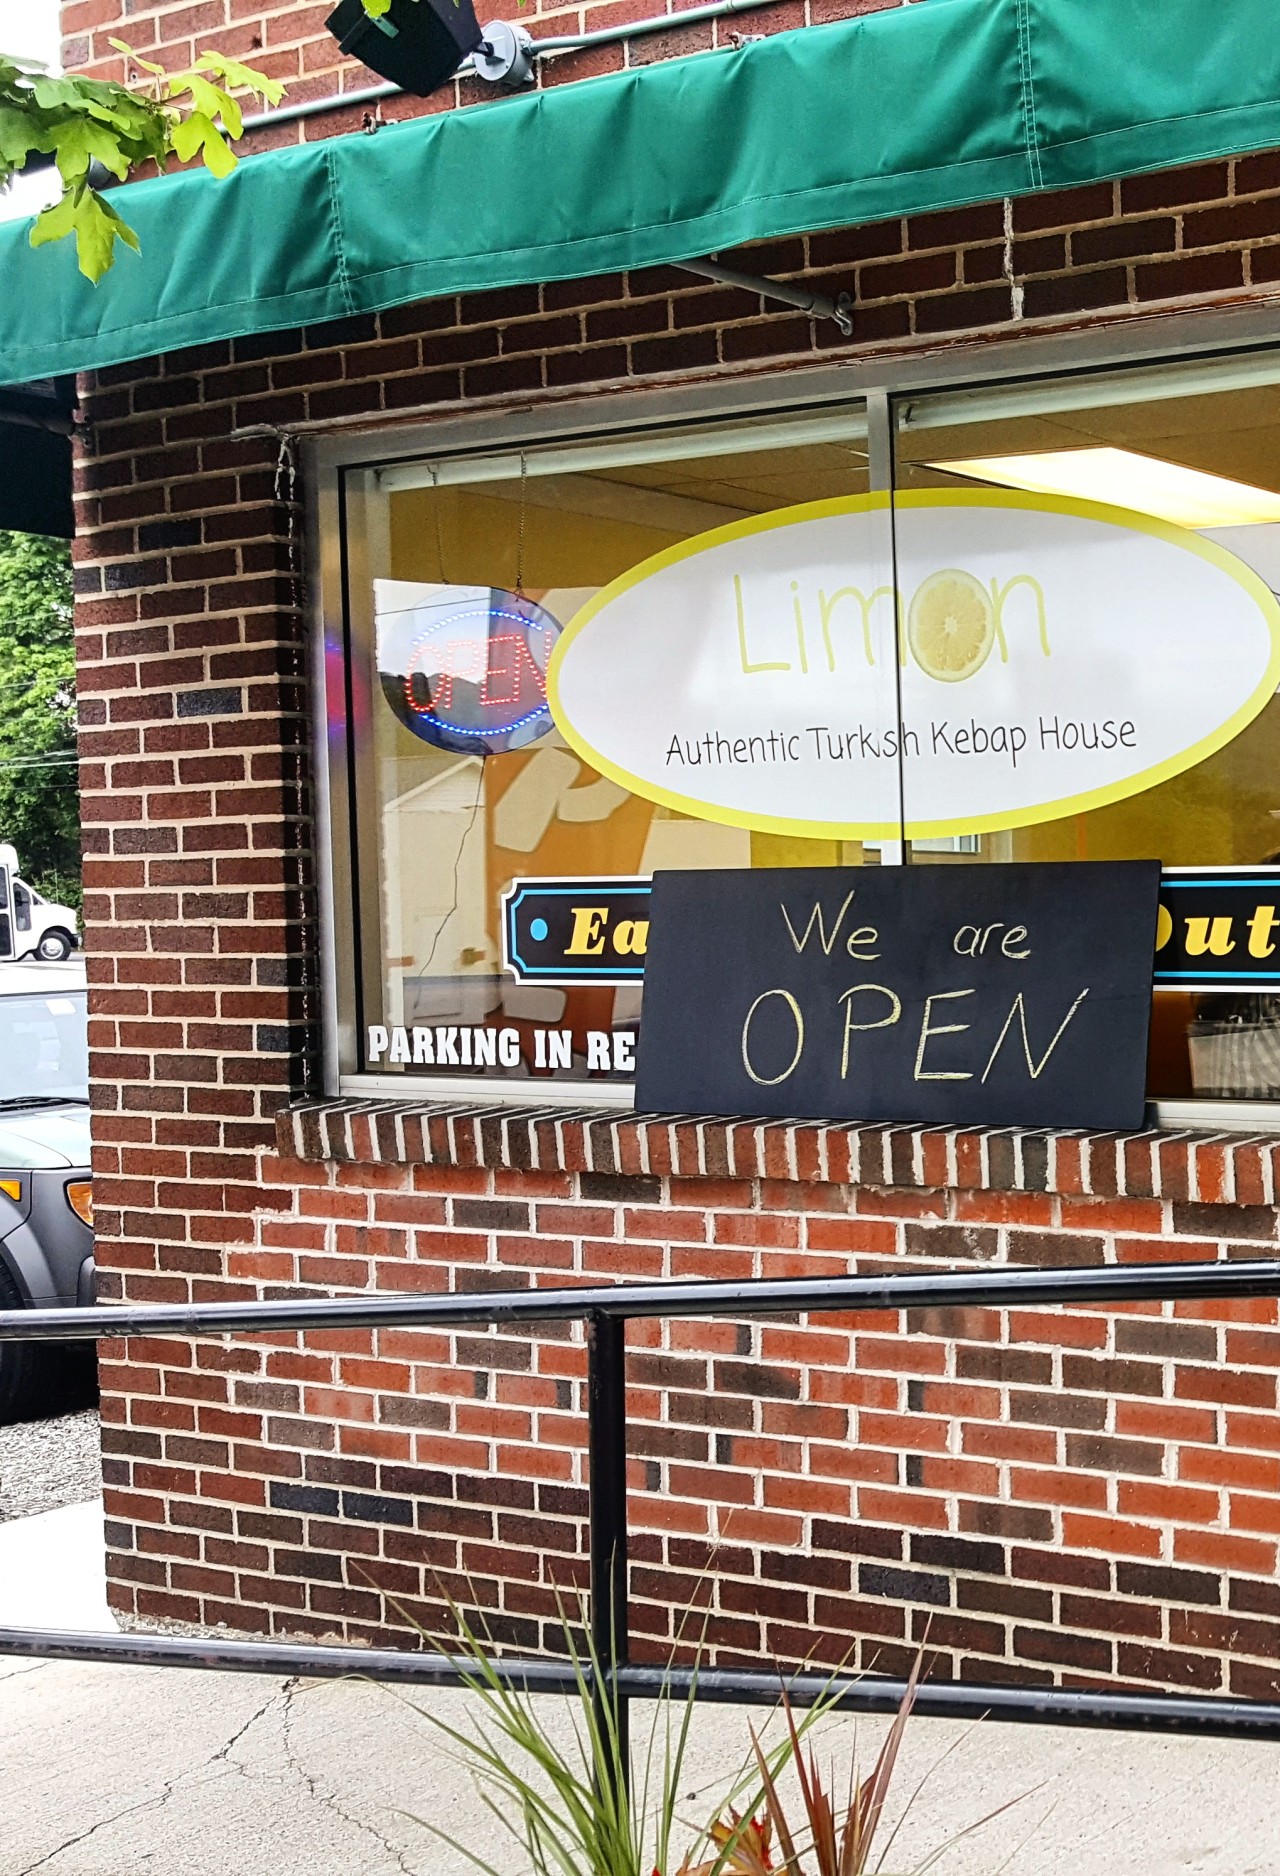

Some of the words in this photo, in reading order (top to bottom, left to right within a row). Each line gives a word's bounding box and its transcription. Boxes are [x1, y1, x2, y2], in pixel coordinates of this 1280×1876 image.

[734, 568, 1051, 682] Limon
[665, 727, 800, 765] Authentic
[931, 718, 1026, 767] Kebap
[1039, 716, 1137, 751] House
[781, 890, 882, 960] We
[953, 921, 1031, 960] are
[368, 1025, 520, 1067] PARKING
[534, 1029, 572, 1069] IN
[741, 983, 1089, 1086] OPEN
